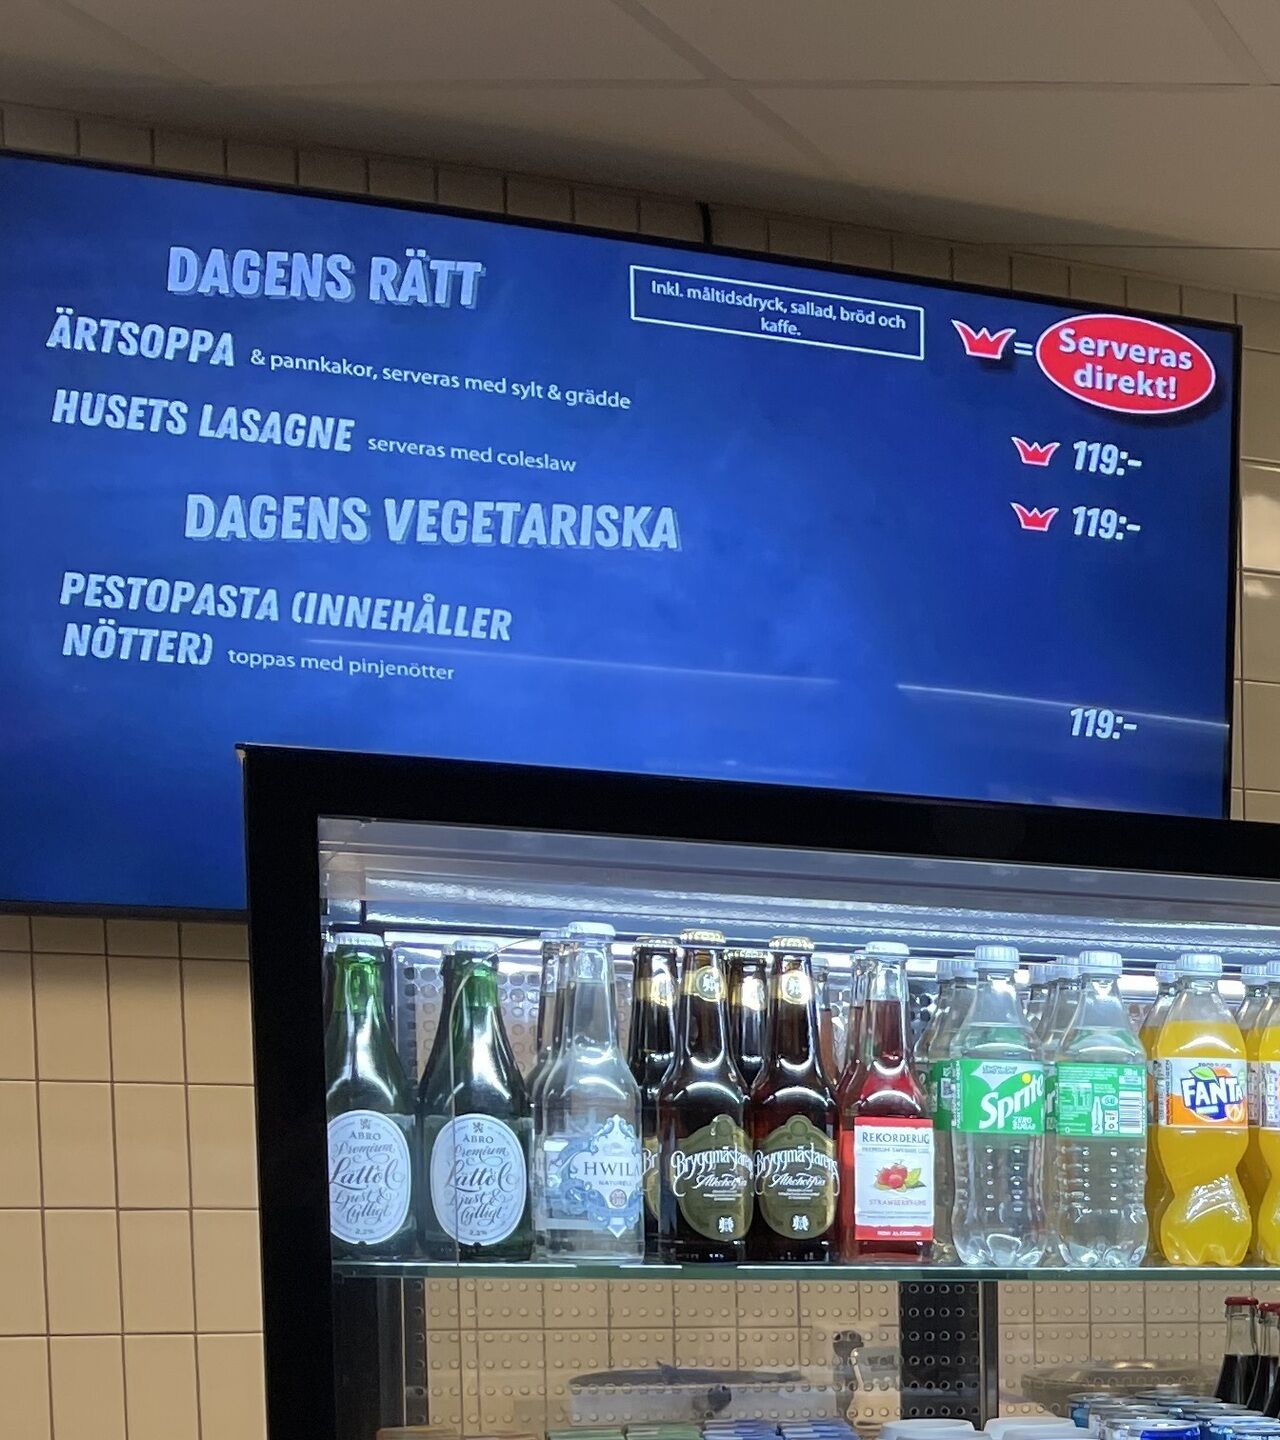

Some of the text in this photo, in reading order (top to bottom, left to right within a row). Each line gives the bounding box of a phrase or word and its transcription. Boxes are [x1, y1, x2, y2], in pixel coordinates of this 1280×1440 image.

[167, 245, 486, 308] DAGENS RÄTT
[651, 280, 906, 329] Inkl. måltidsdryck, sallad, bröd och
[761, 317, 801, 336] kaffe.
[46, 307, 632, 409] ÄRTSOPPA & pannkakor, serveras med sylt & grädde
[1059, 327, 1194, 371] Serveras
[1073, 362, 1178, 401] direkt!
[52, 389, 577, 472] HUSETS LASAGNE serveras med coleslaw
[1073, 441, 1142, 476] 119:-
[185, 493, 681, 551] DAGENS VEGETARISKA
[1072, 507, 1141, 541] 119:-
[59, 571, 513, 641] PESTOPASTA (INNEHÅLLER
[62, 618, 456, 682] NÖTTER) toppas med pinjenötter
[1070, 708, 1139, 741] 119:-
[979, 1074, 1045, 1129] Sprite
[1180, 1076, 1244, 1107] FANTA
[862, 1131, 930, 1145] REKORDERLIG
